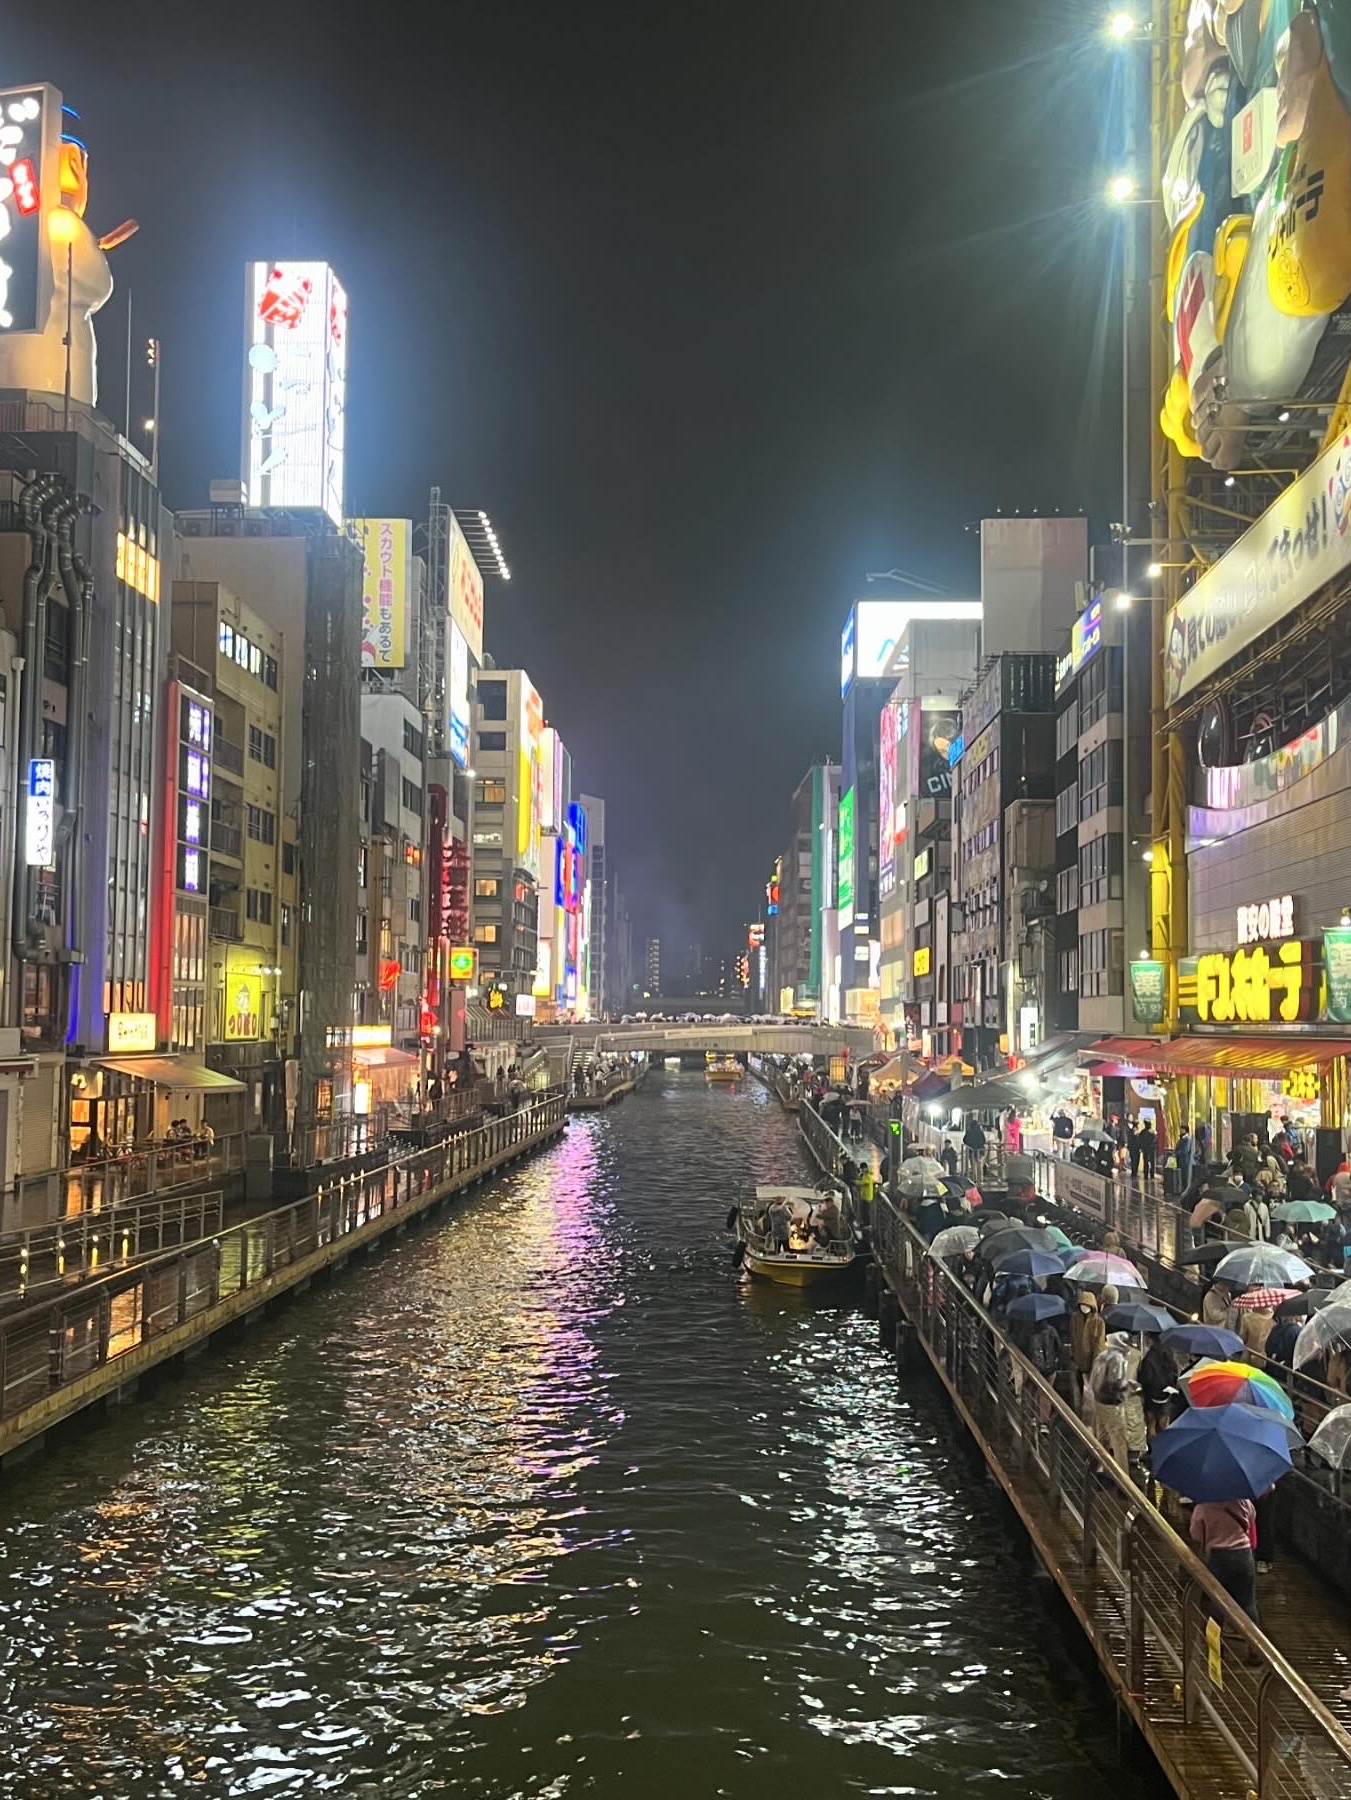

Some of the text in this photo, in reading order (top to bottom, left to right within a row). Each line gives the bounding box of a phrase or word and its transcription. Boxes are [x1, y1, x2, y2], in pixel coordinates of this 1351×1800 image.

[35, 761, 51, 796] 焼肉
[36, 801, 50, 862] いろりや
